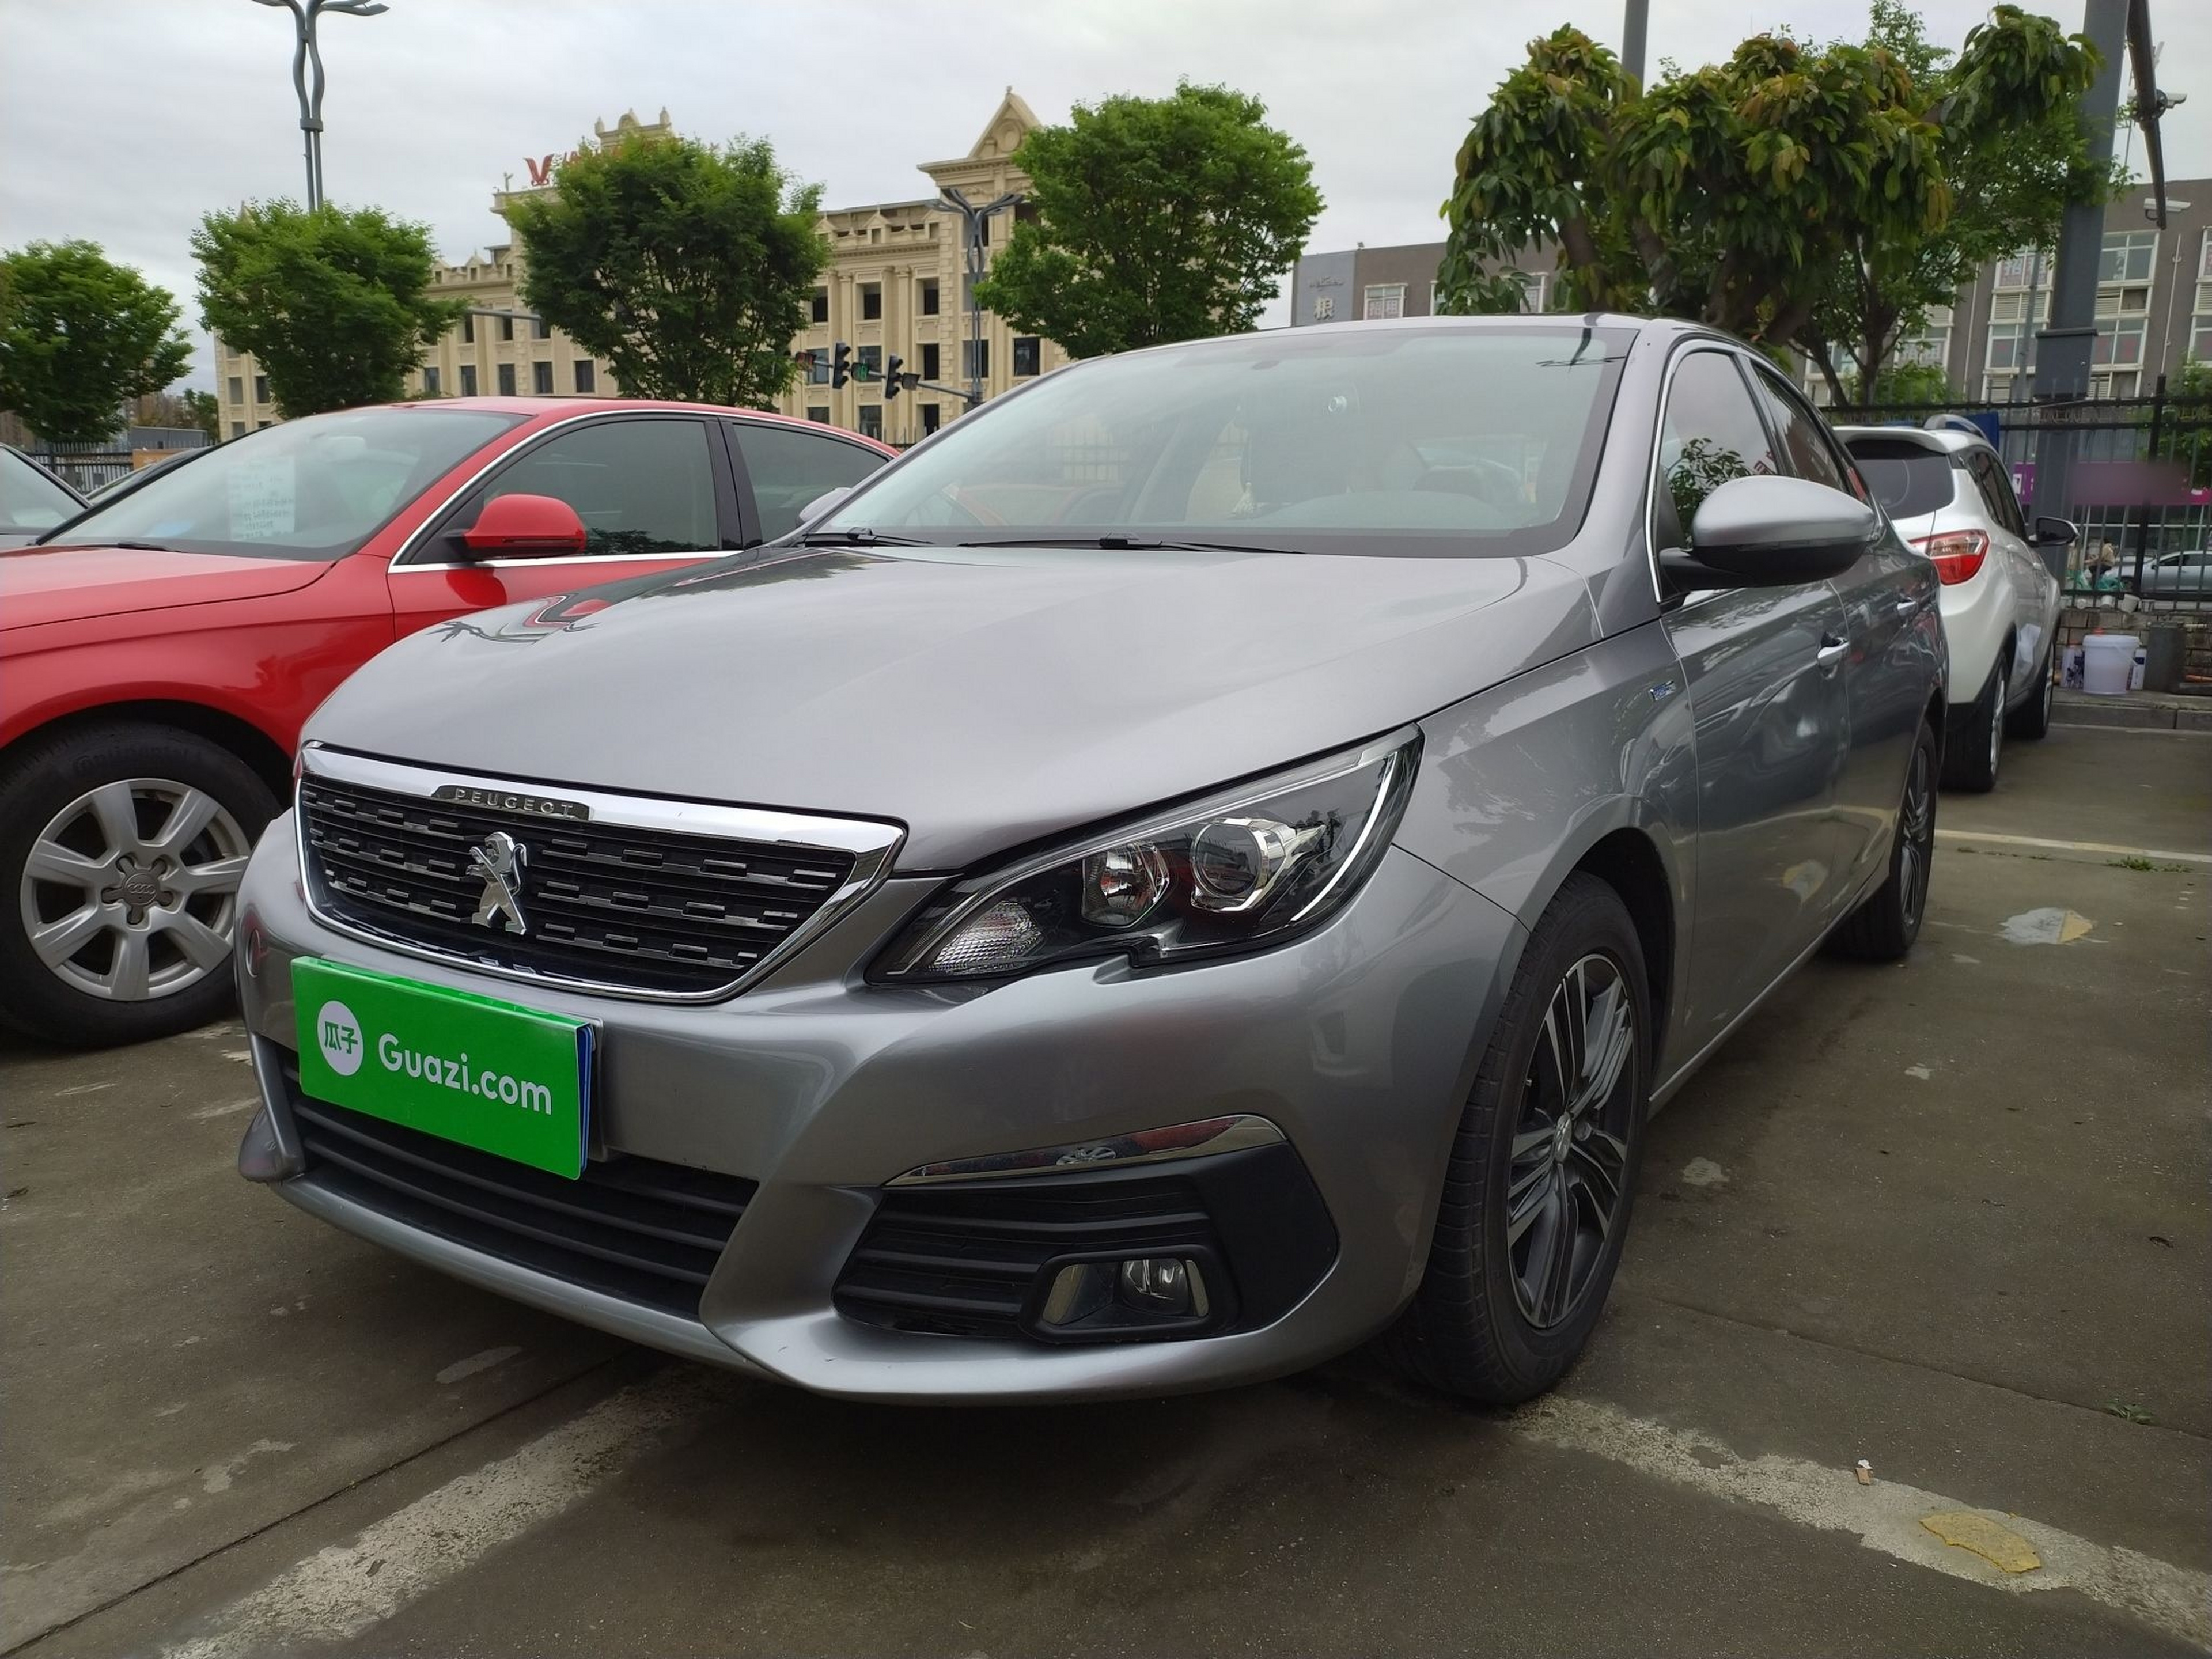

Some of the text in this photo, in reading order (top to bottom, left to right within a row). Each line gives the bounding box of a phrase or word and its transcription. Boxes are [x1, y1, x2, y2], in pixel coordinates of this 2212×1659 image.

[454, 787, 574, 817] PEUGEOT
[324, 1021, 552, 1115] 瓜子 Guazi.com
